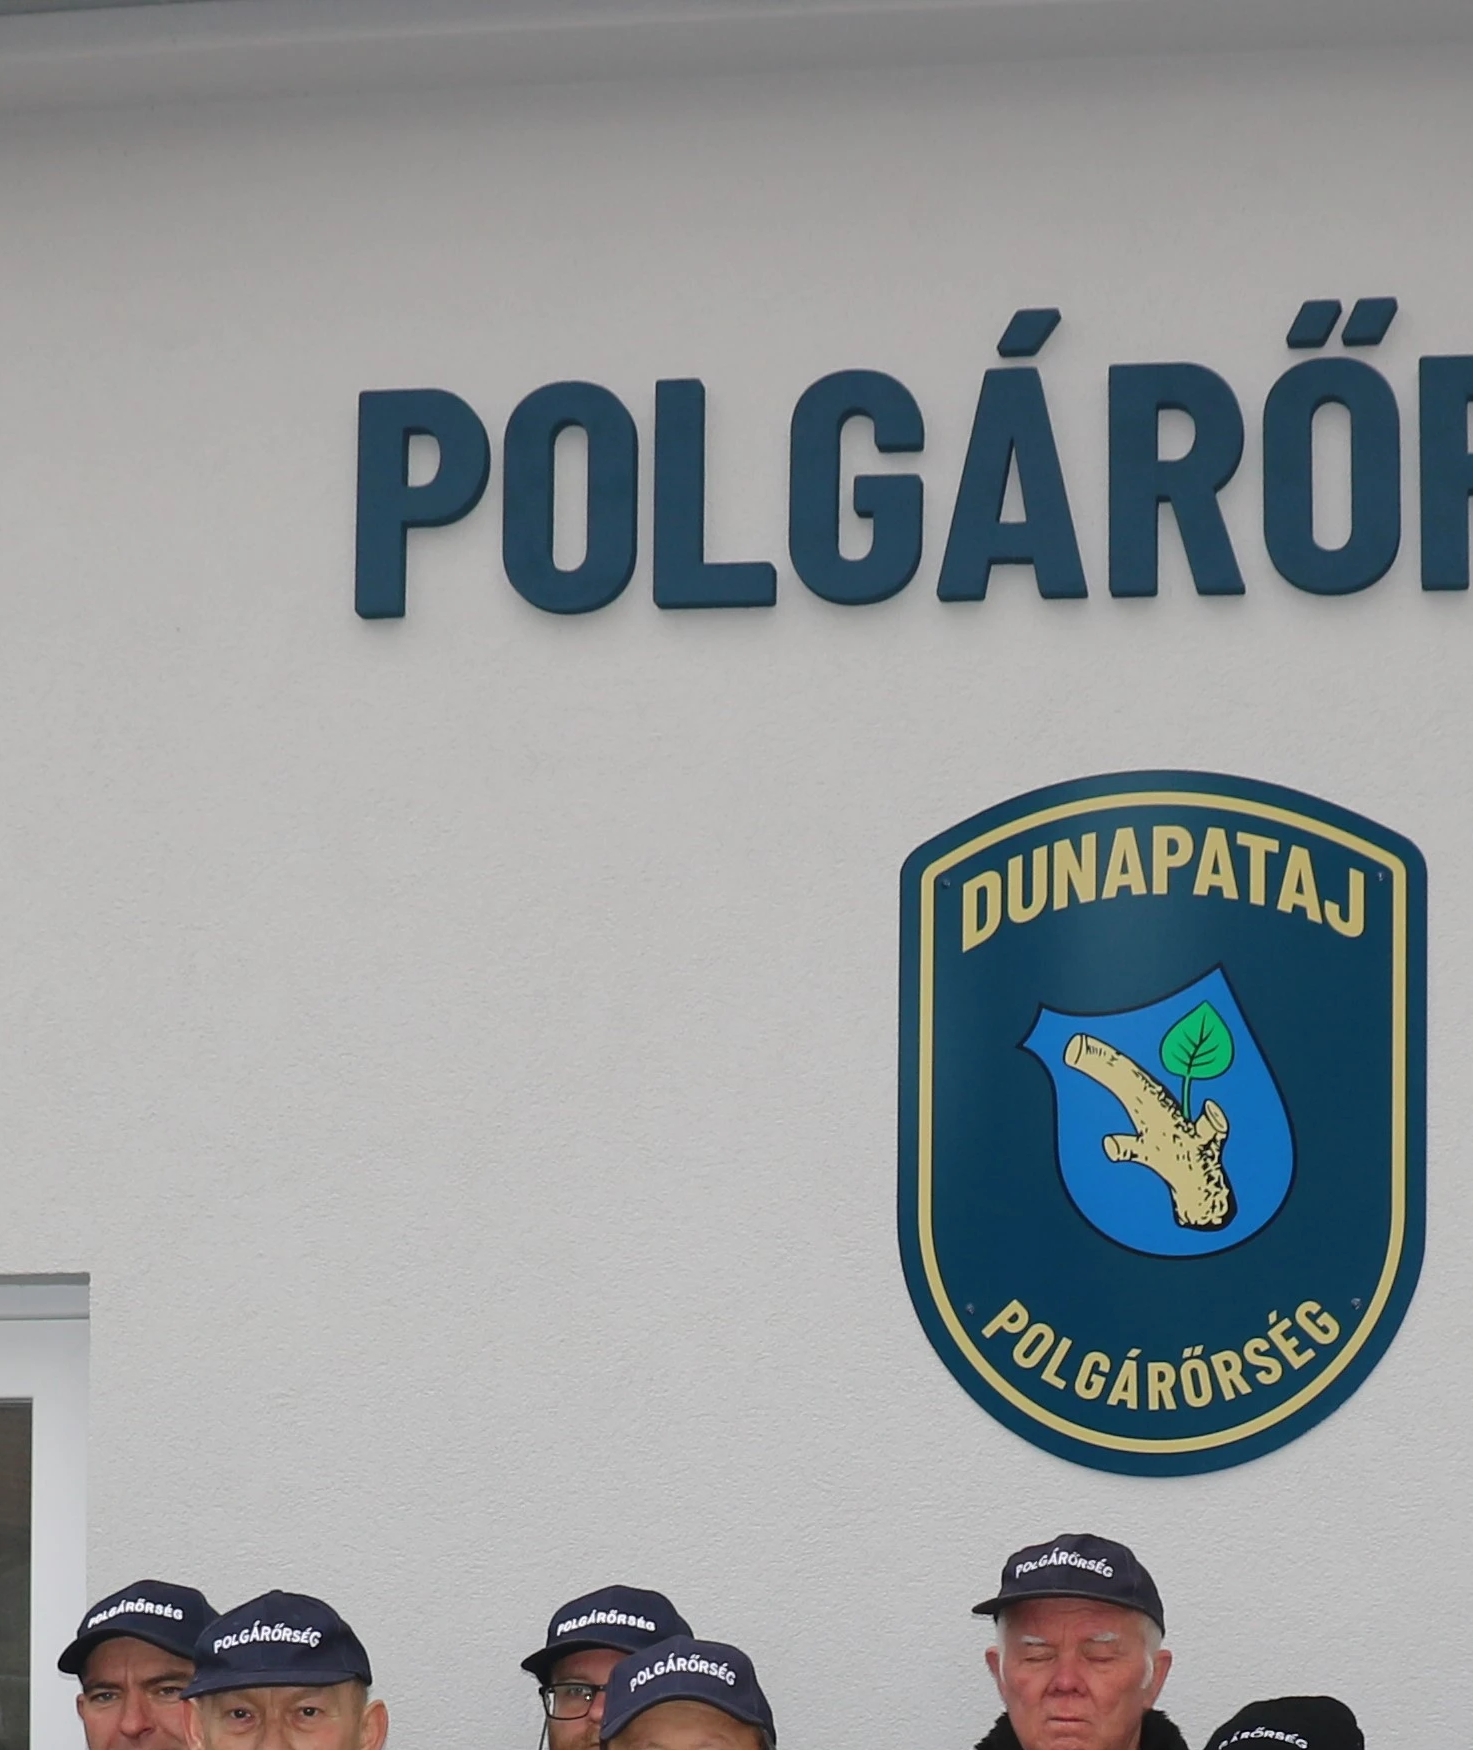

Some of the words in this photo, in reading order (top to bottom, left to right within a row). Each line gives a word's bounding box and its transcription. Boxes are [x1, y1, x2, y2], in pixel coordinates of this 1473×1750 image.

[962, 825, 1366, 953] DUNAPATAJ
[981, 1300, 1342, 1412] POLGÁRŐRSÉG
[1015, 1547, 1114, 1579] POLGÁRŐRSÉG
[87, 1597, 184, 1629] POLGÁRŐRSÉG
[555, 1608, 656, 1637] POLGÁRŐRSÉG
[213, 1619, 322, 1655] POLGÁRŐRSÉG
[629, 1652, 736, 1693] POLGÁRŐRSÉG
